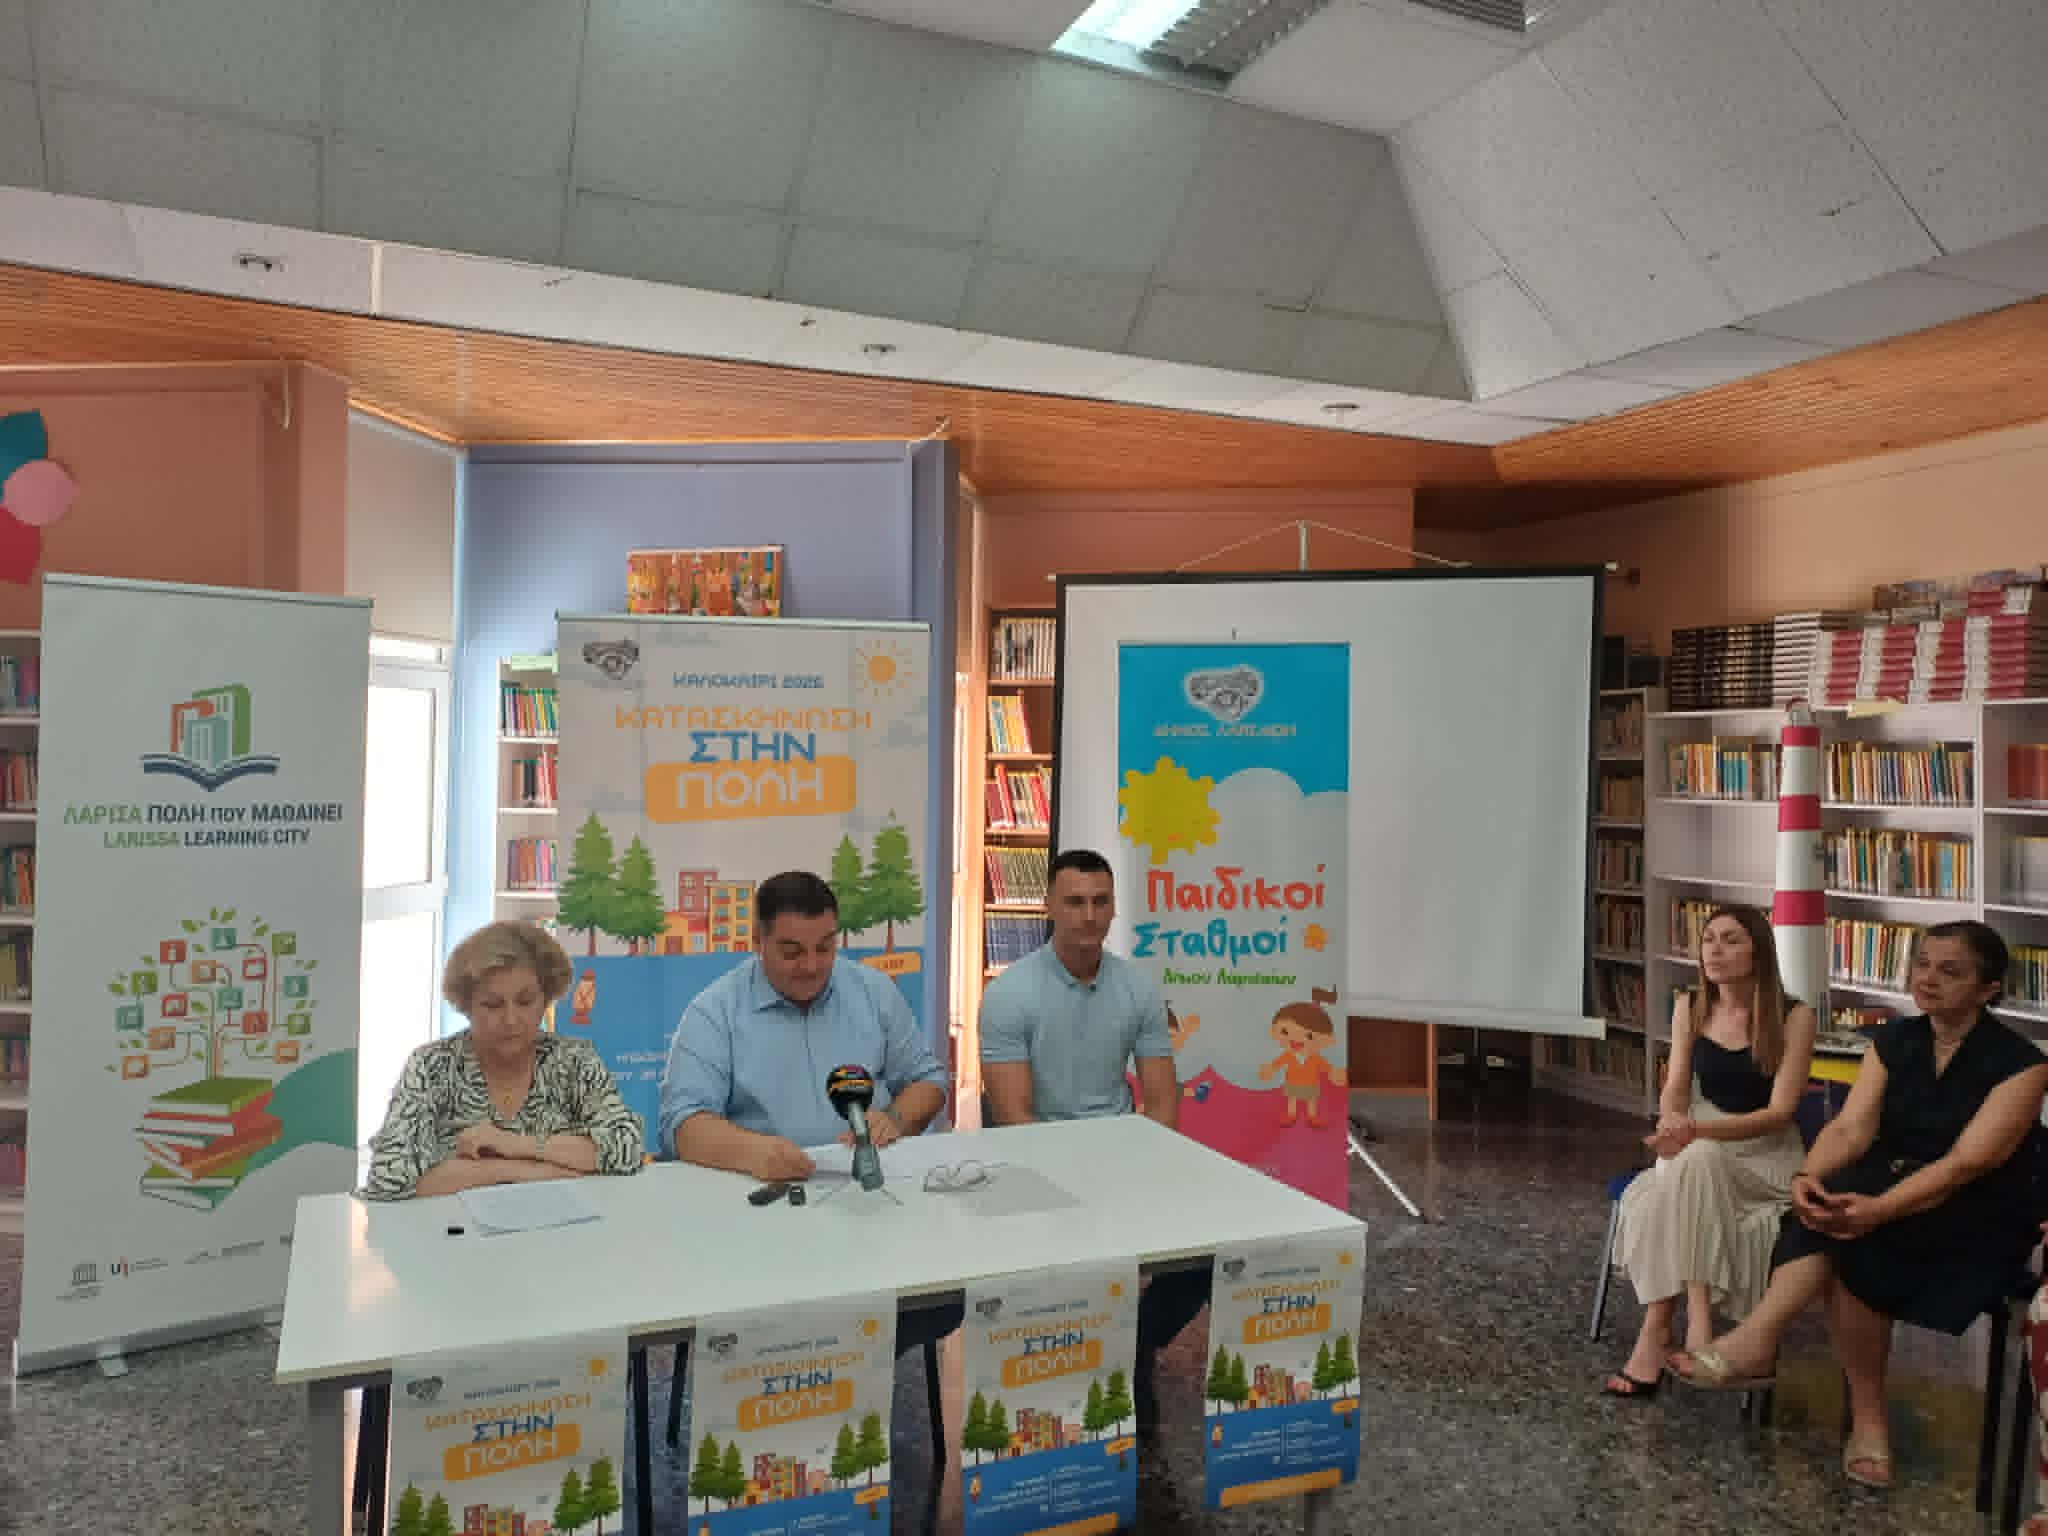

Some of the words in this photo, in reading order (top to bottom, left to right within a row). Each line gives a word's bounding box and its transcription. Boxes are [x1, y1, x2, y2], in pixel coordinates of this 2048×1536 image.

[615, 705, 871, 730] ΚΑΤΑΣΚΗΝΩΣΗ
[689, 731, 815, 763] ΣΤΗΝ
[677, 768, 823, 809] ΠΟΛΗ
[64, 804, 142, 824] ΛΑΡΙΣΑ
[147, 804, 205, 823] ΠΟΛΗ
[252, 803, 342, 822] ΜΑΘΑΙΝΕΙ
[104, 832, 179, 848] LARISSA
[184, 829, 269, 847] LEARNING
[272, 828, 311, 845] CITY
[1147, 864, 1326, 912] Παιδικοί
[1132, 916, 1287, 967] Σταθμοί
[472, 1413, 554, 1442] ΣΤΗΝ
[463, 1433, 558, 1473] ΠΟΛΗ
